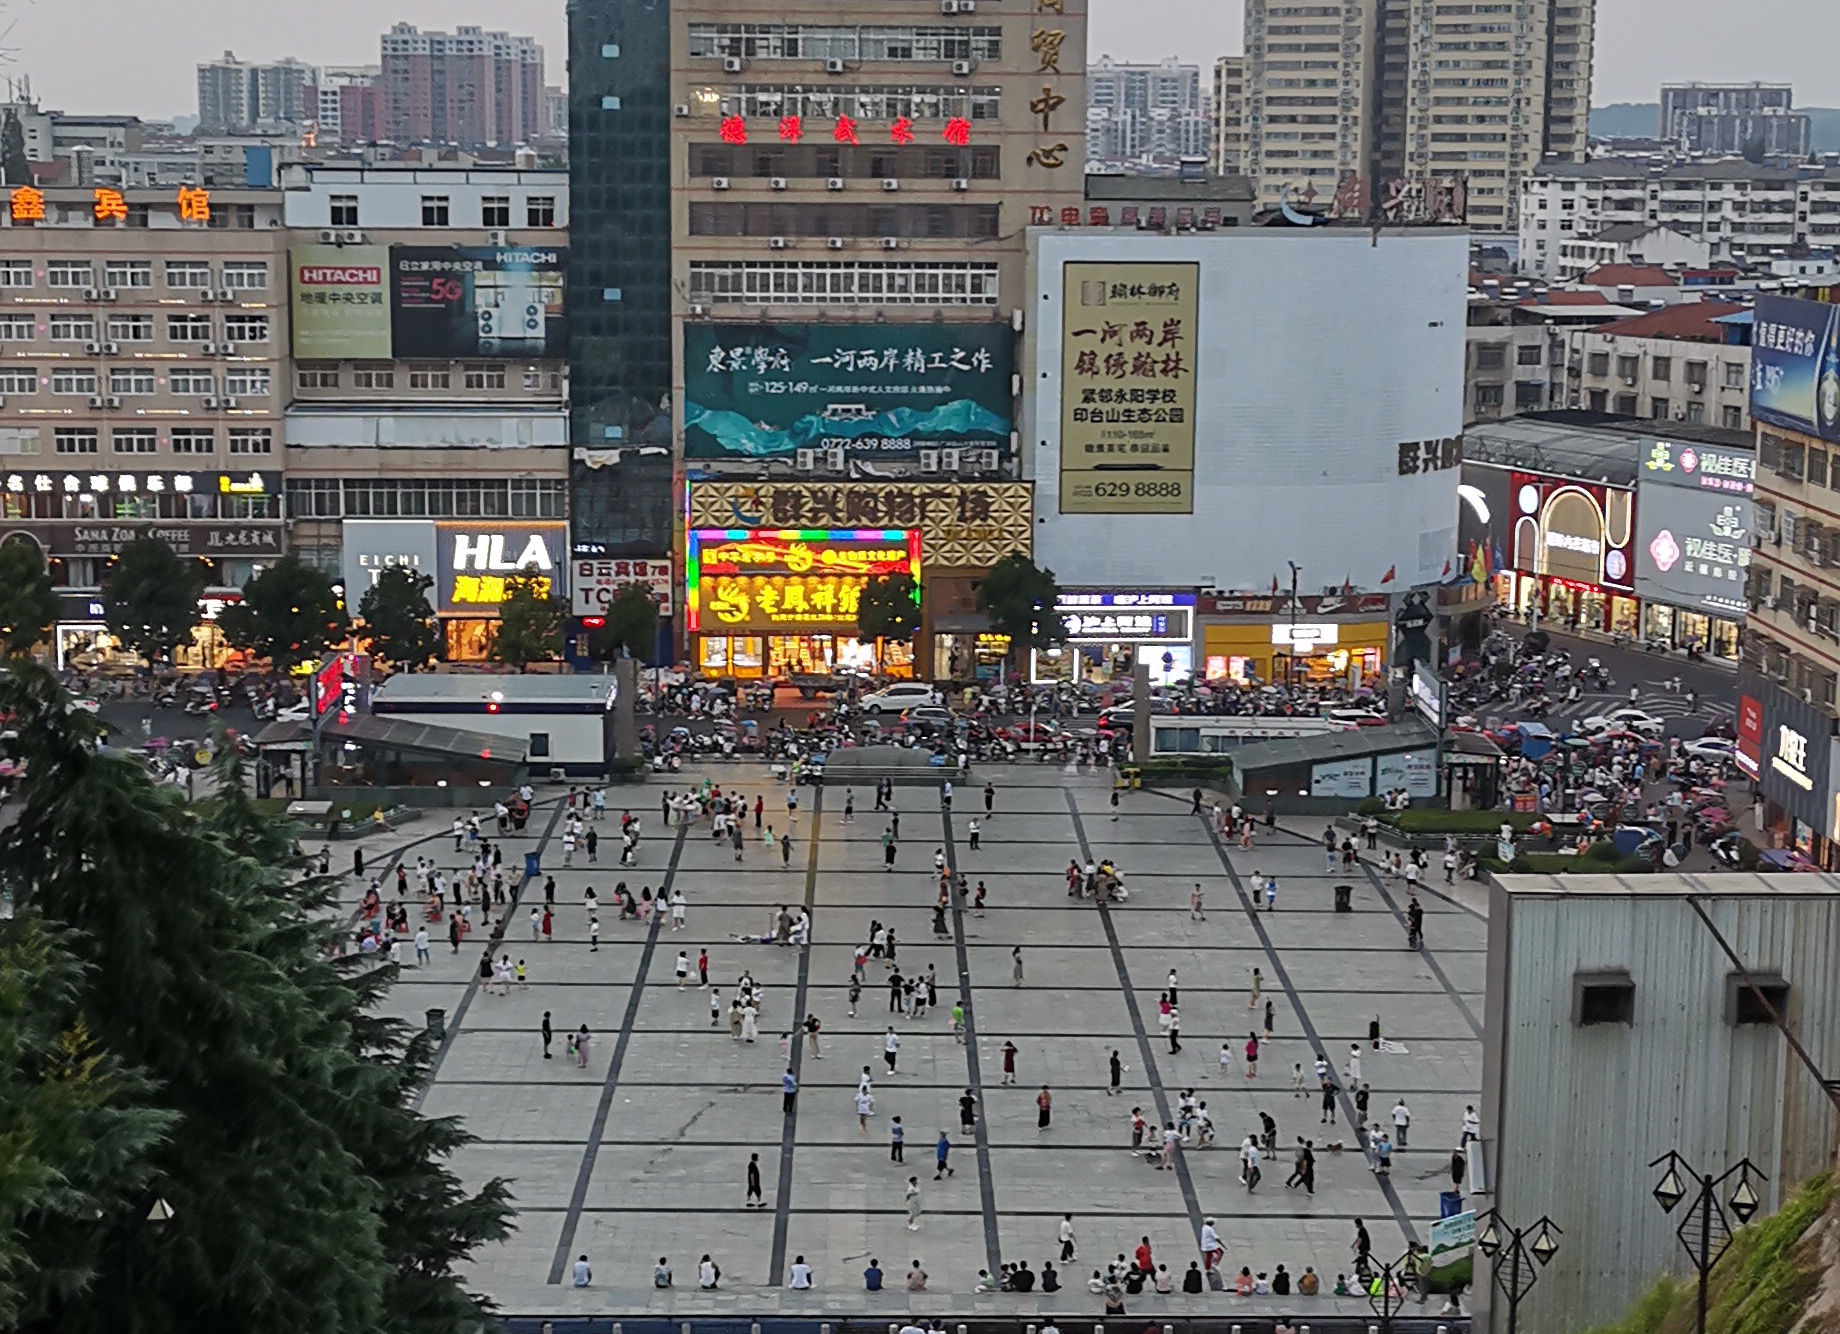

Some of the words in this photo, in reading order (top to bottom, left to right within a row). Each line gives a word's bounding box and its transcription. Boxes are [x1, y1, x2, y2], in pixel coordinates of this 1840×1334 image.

[10, 185, 211, 221] 鑫宾馆
[496, 252, 557, 264] HITACHI
[303, 269, 378, 283] HITACHI
[430, 277, 463, 301] 5G
[1071, 318, 1184, 349] 一河两岸
[810, 348, 994, 373] 一河两岸精工之作
[1074, 350, 1189, 380] 锦绣翰林
[1081, 388, 1177, 404] 紧邻永阳学校
[1073, 407, 1184, 423] 印台山生态公园
[881, 438, 911, 450] 8888
[1094, 482, 1130, 497] 629
[1134, 482, 1181, 497] 8888
[453, 534, 552, 569] HLA
[359, 554, 419, 567] EICHI
